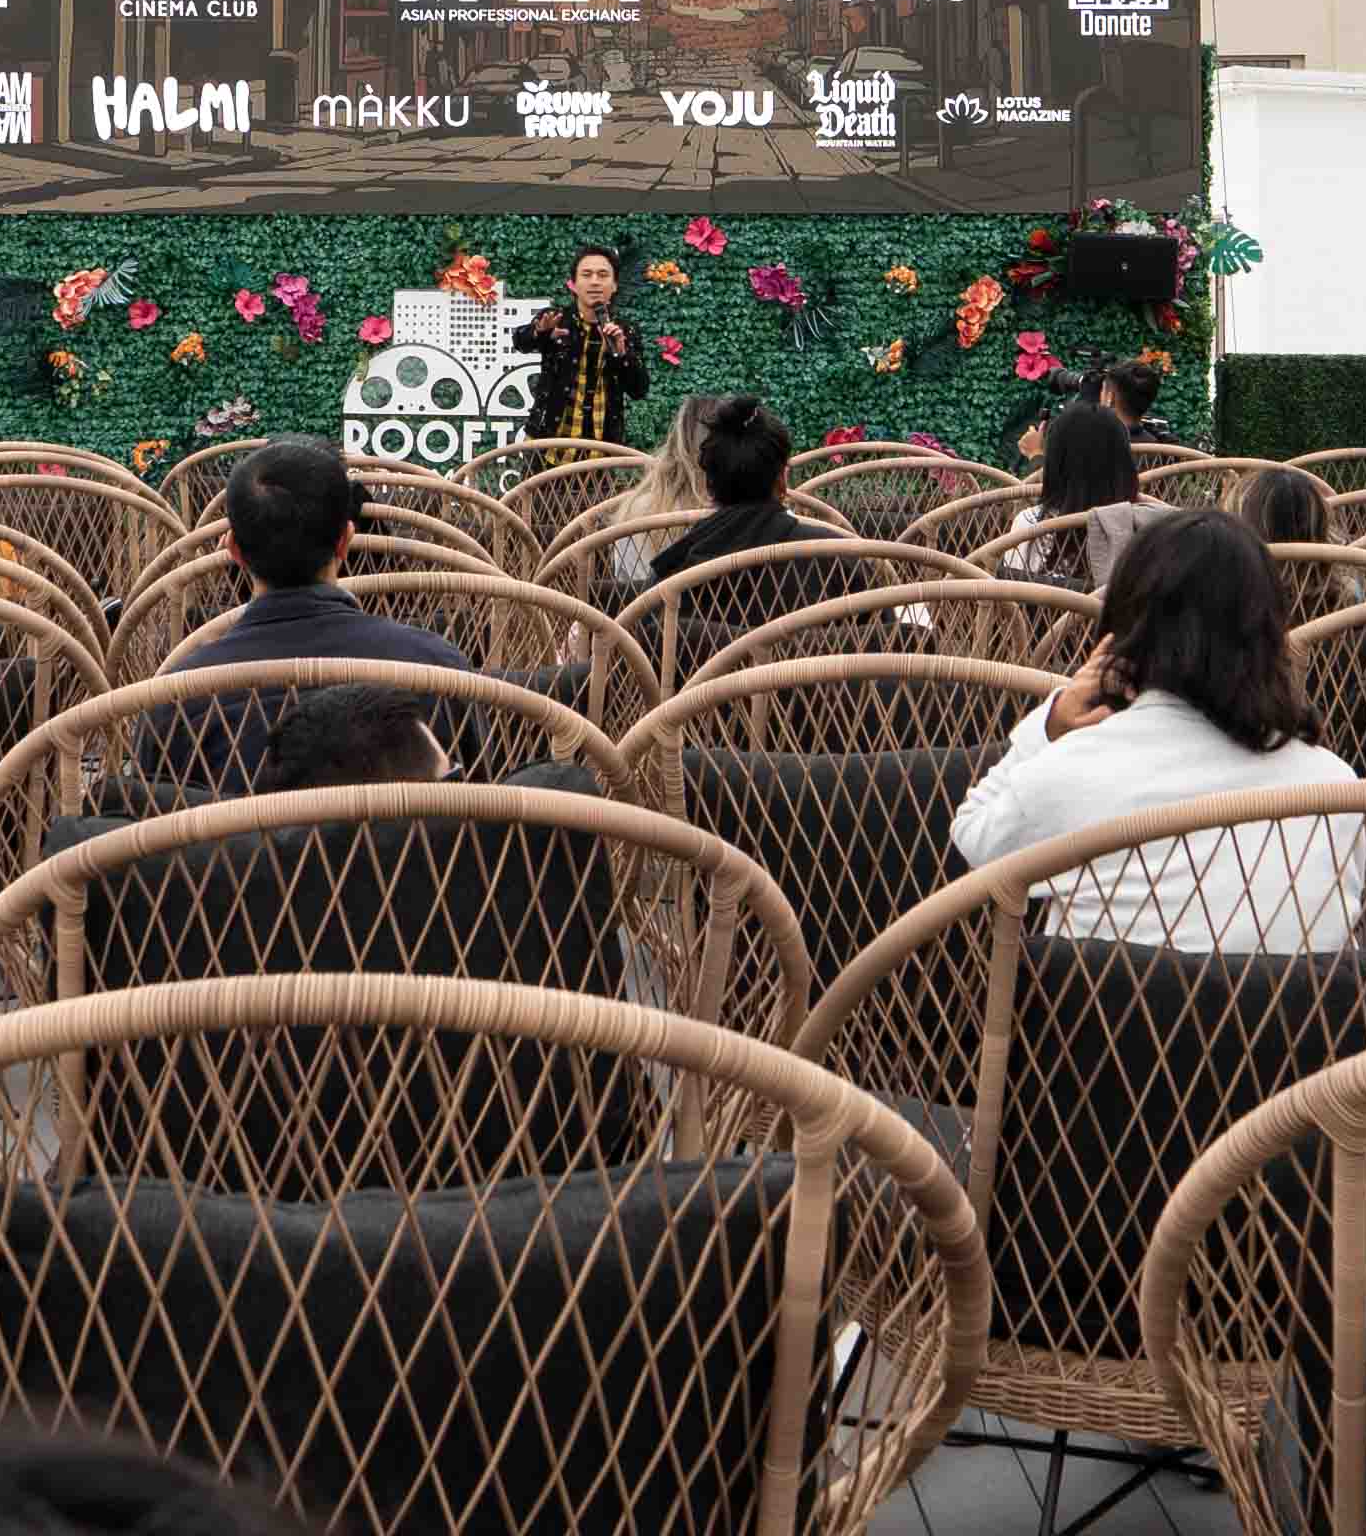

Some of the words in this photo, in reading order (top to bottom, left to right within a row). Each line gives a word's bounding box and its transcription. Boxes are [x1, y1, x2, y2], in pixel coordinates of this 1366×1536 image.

[119, 0, 198, 17] CINEMA
[207, 0, 258, 17] CLUB
[400, 8, 445, 22] ASIAN
[448, 8, 558, 22] PROFESSIONAL
[561, 8, 640, 22] EXCHANGE
[1080, 11, 1152, 36] Donate
[516, 88, 613, 114] DRUNK
[806, 69, 897, 111] Liquid
[996, 96, 1042, 109] LOTUS
[92, 76, 251, 141] HALMI
[313, 83, 470, 127] MÀKKU
[660, 90, 775, 127] YOJU
[996, 109, 1071, 122] MAGAZINE
[524, 114, 603, 138] FRUIT
[814, 103, 897, 138] Death
[343, 419, 527, 464] ROOFT
